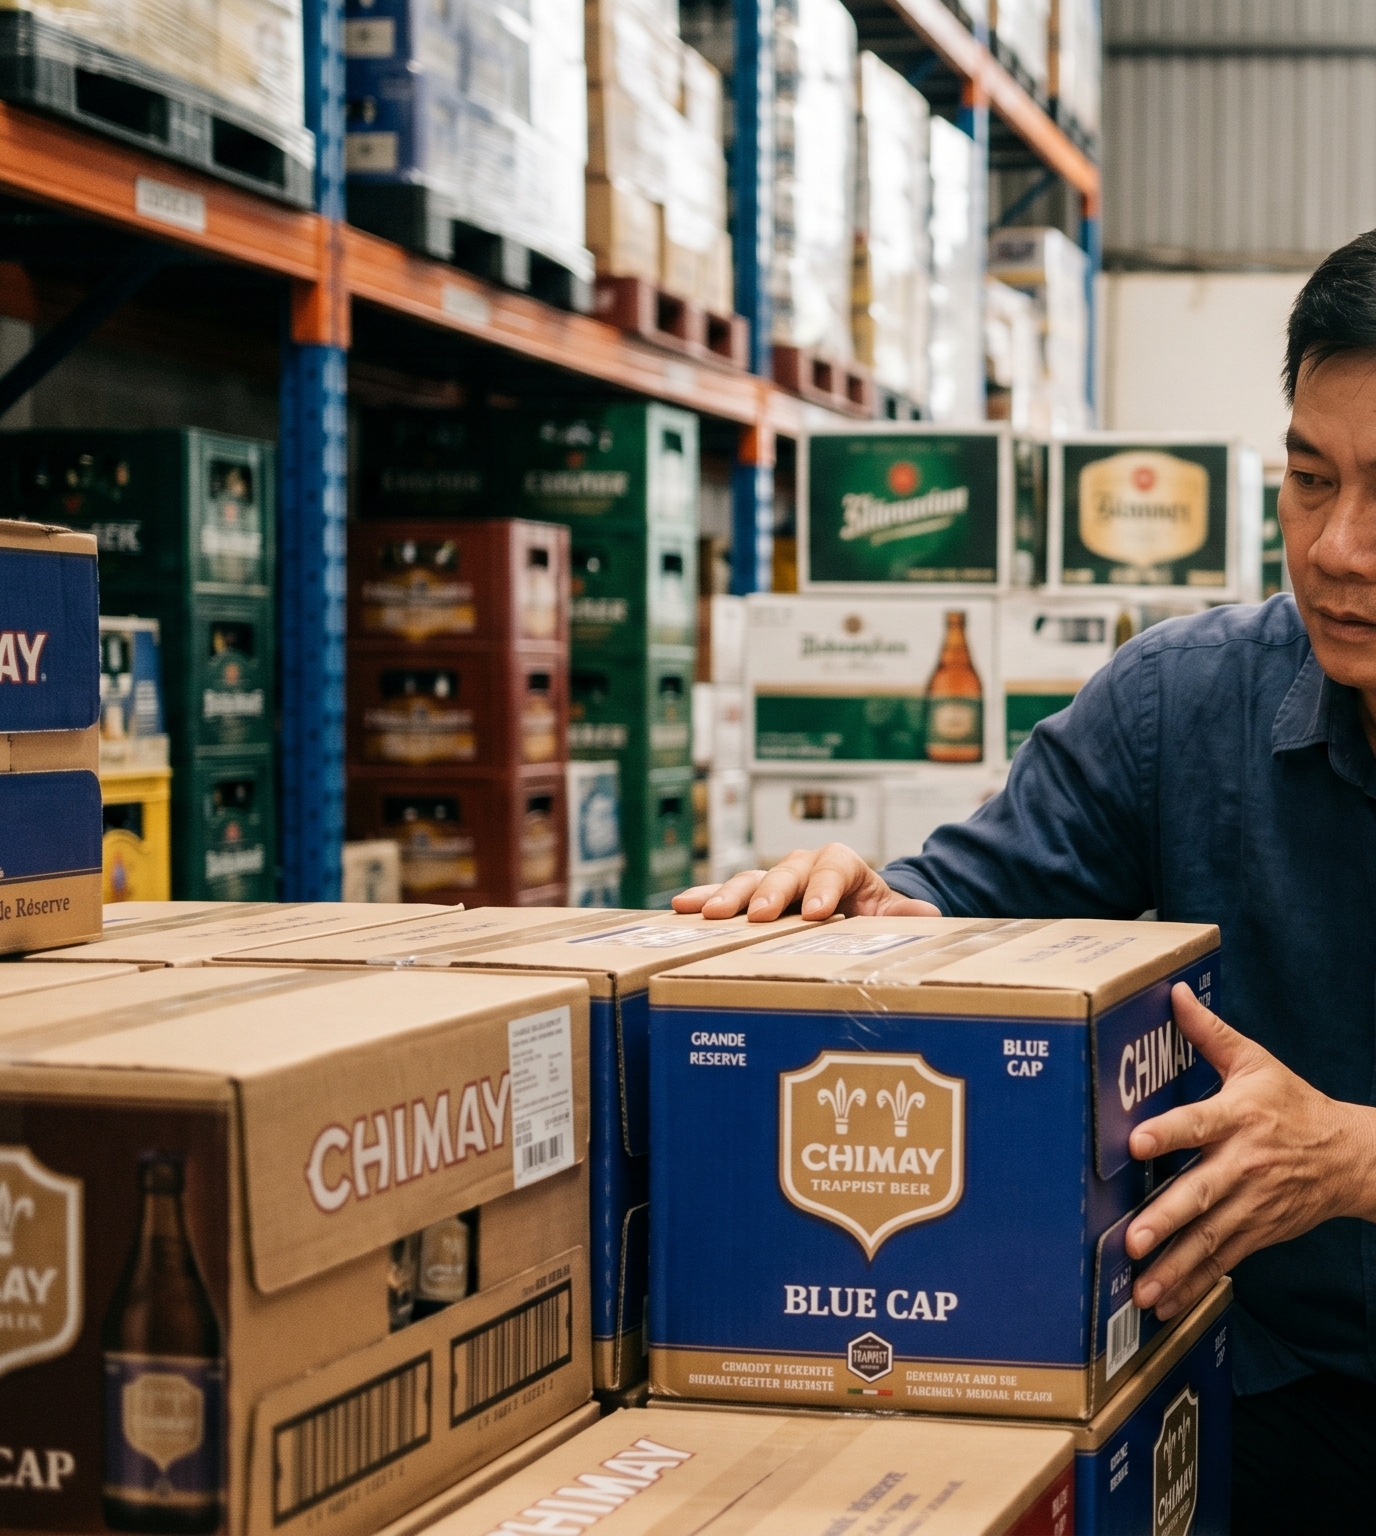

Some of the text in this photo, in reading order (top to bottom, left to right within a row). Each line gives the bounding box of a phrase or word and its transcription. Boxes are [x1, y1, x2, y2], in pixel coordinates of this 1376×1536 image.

[691, 1031, 746, 1048] GRANDE
[1003, 1038, 1050, 1057] BLUE
[689, 1051, 747, 1067] RESERVE
[1006, 1059, 1044, 1077] CAP
[305, 1070, 512, 1215] CHIMAY
[801, 1142, 946, 1176] CHIMAY
[810, 1178, 931, 1196] TRAPPIST BEER
[783, 1284, 959, 1321] BLUE CAP
[852, 1349, 888, 1364] TRAPPIST
[482, 1437, 697, 1536] HIMAY
[1158, 1460, 1194, 1526] CHIMAY
